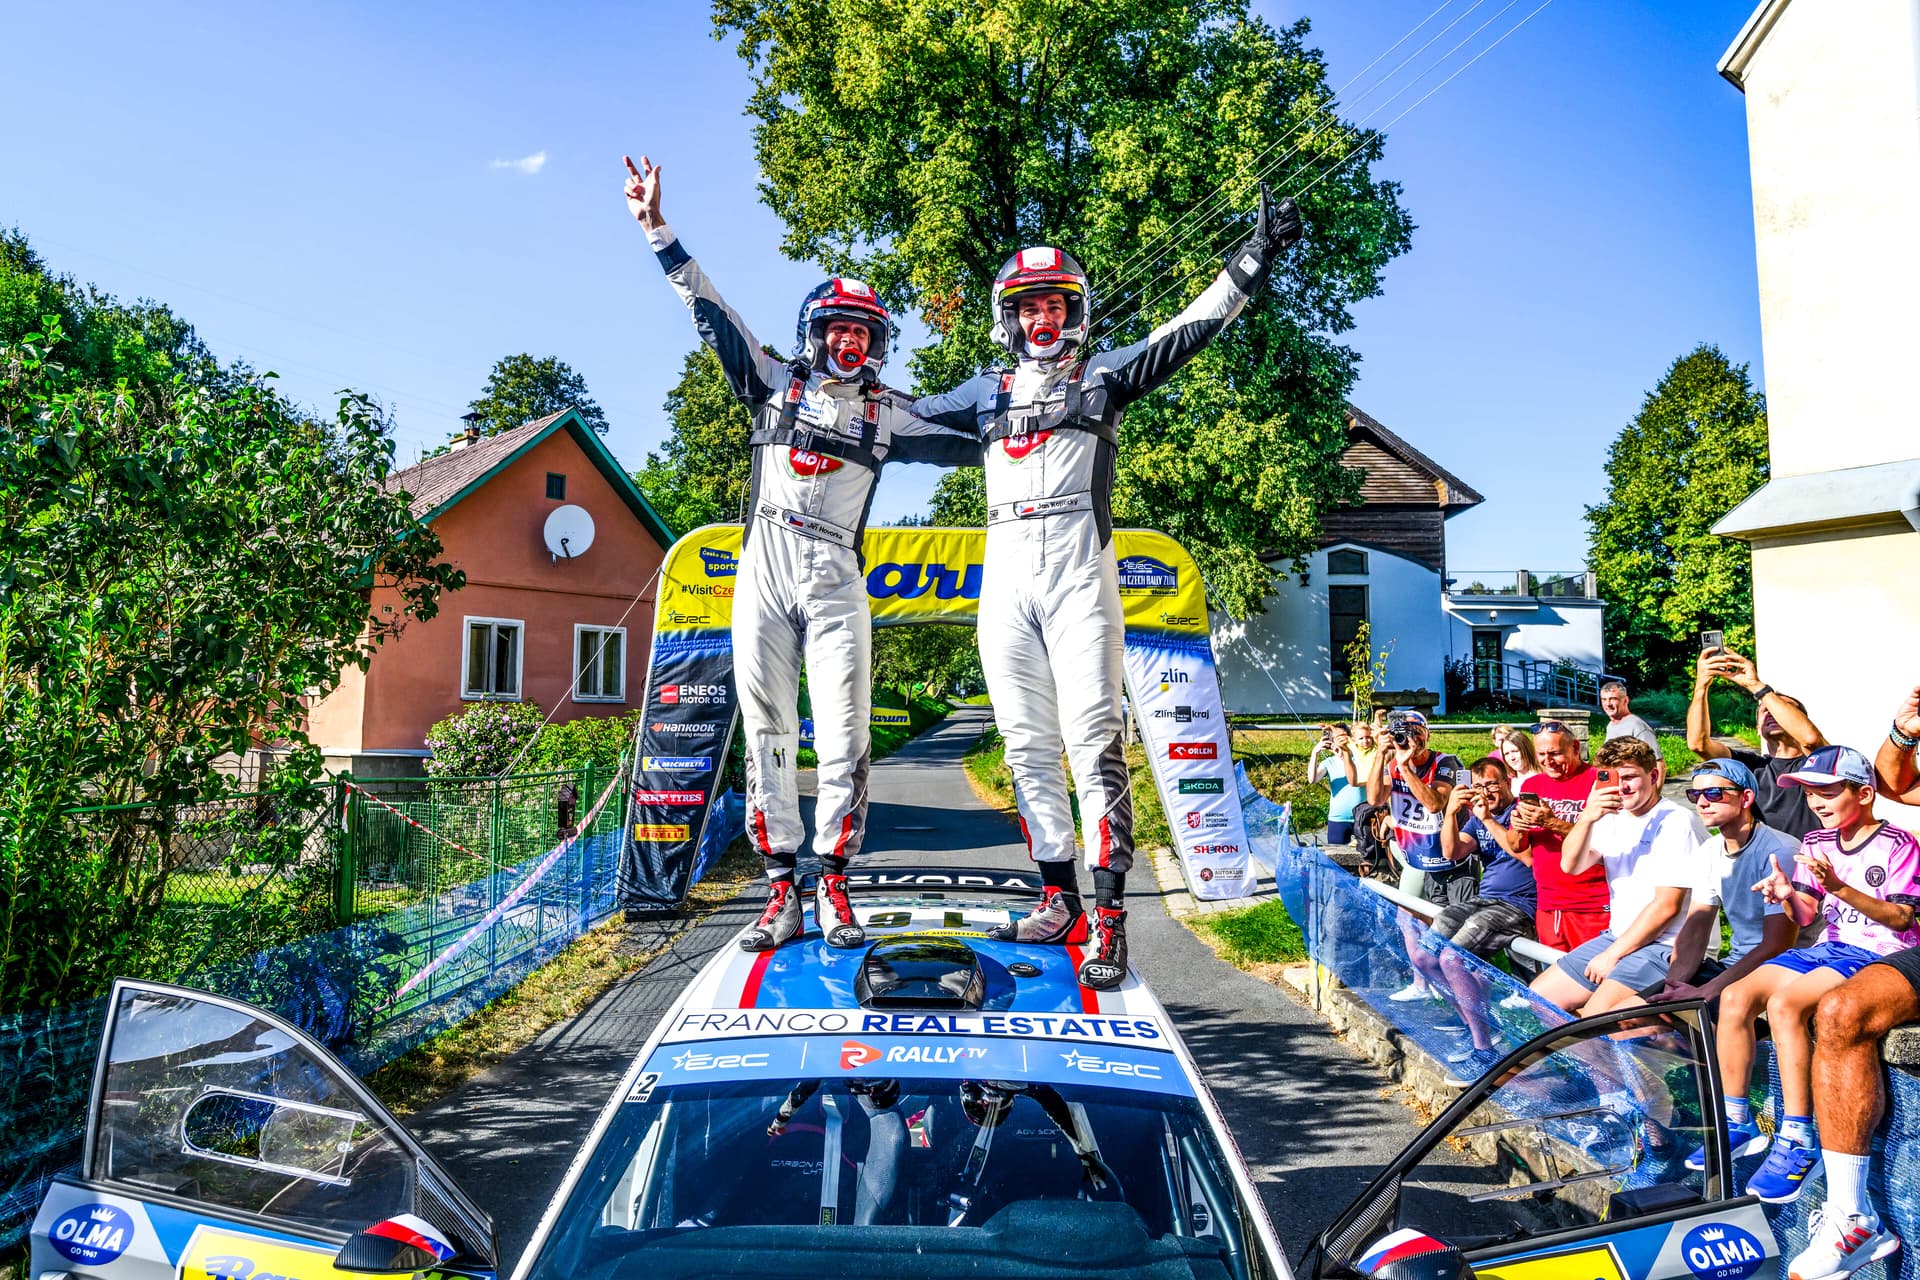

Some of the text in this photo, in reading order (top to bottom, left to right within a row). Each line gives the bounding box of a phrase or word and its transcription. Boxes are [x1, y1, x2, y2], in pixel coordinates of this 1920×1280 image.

[792, 450, 829, 470] MOL
[1127, 574, 1146, 587] CZECH
[680, 685, 727, 697] ENEOS
[712, 696, 727, 704] OIL
[870, 714, 908, 723] arum
[1191, 709, 1210, 720] kraj
[661, 759, 706, 768] MICHELIN
[669, 793, 703, 803] TYRES
[1402, 798, 1430, 822] 25
[678, 1013, 1160, 1039] FRANCO REAL ESTATES
[684, 1053, 769, 1071] ERC
[886, 1046, 964, 1063] RALLY
[1077, 1056, 1162, 1080] ERC
[56, 1218, 125, 1252] OLMA
[70, 1246, 98, 1259] OD 1967
[1689, 1238, 1760, 1270] OLMA
[1717, 1266, 1744, 1278] OD 1967
